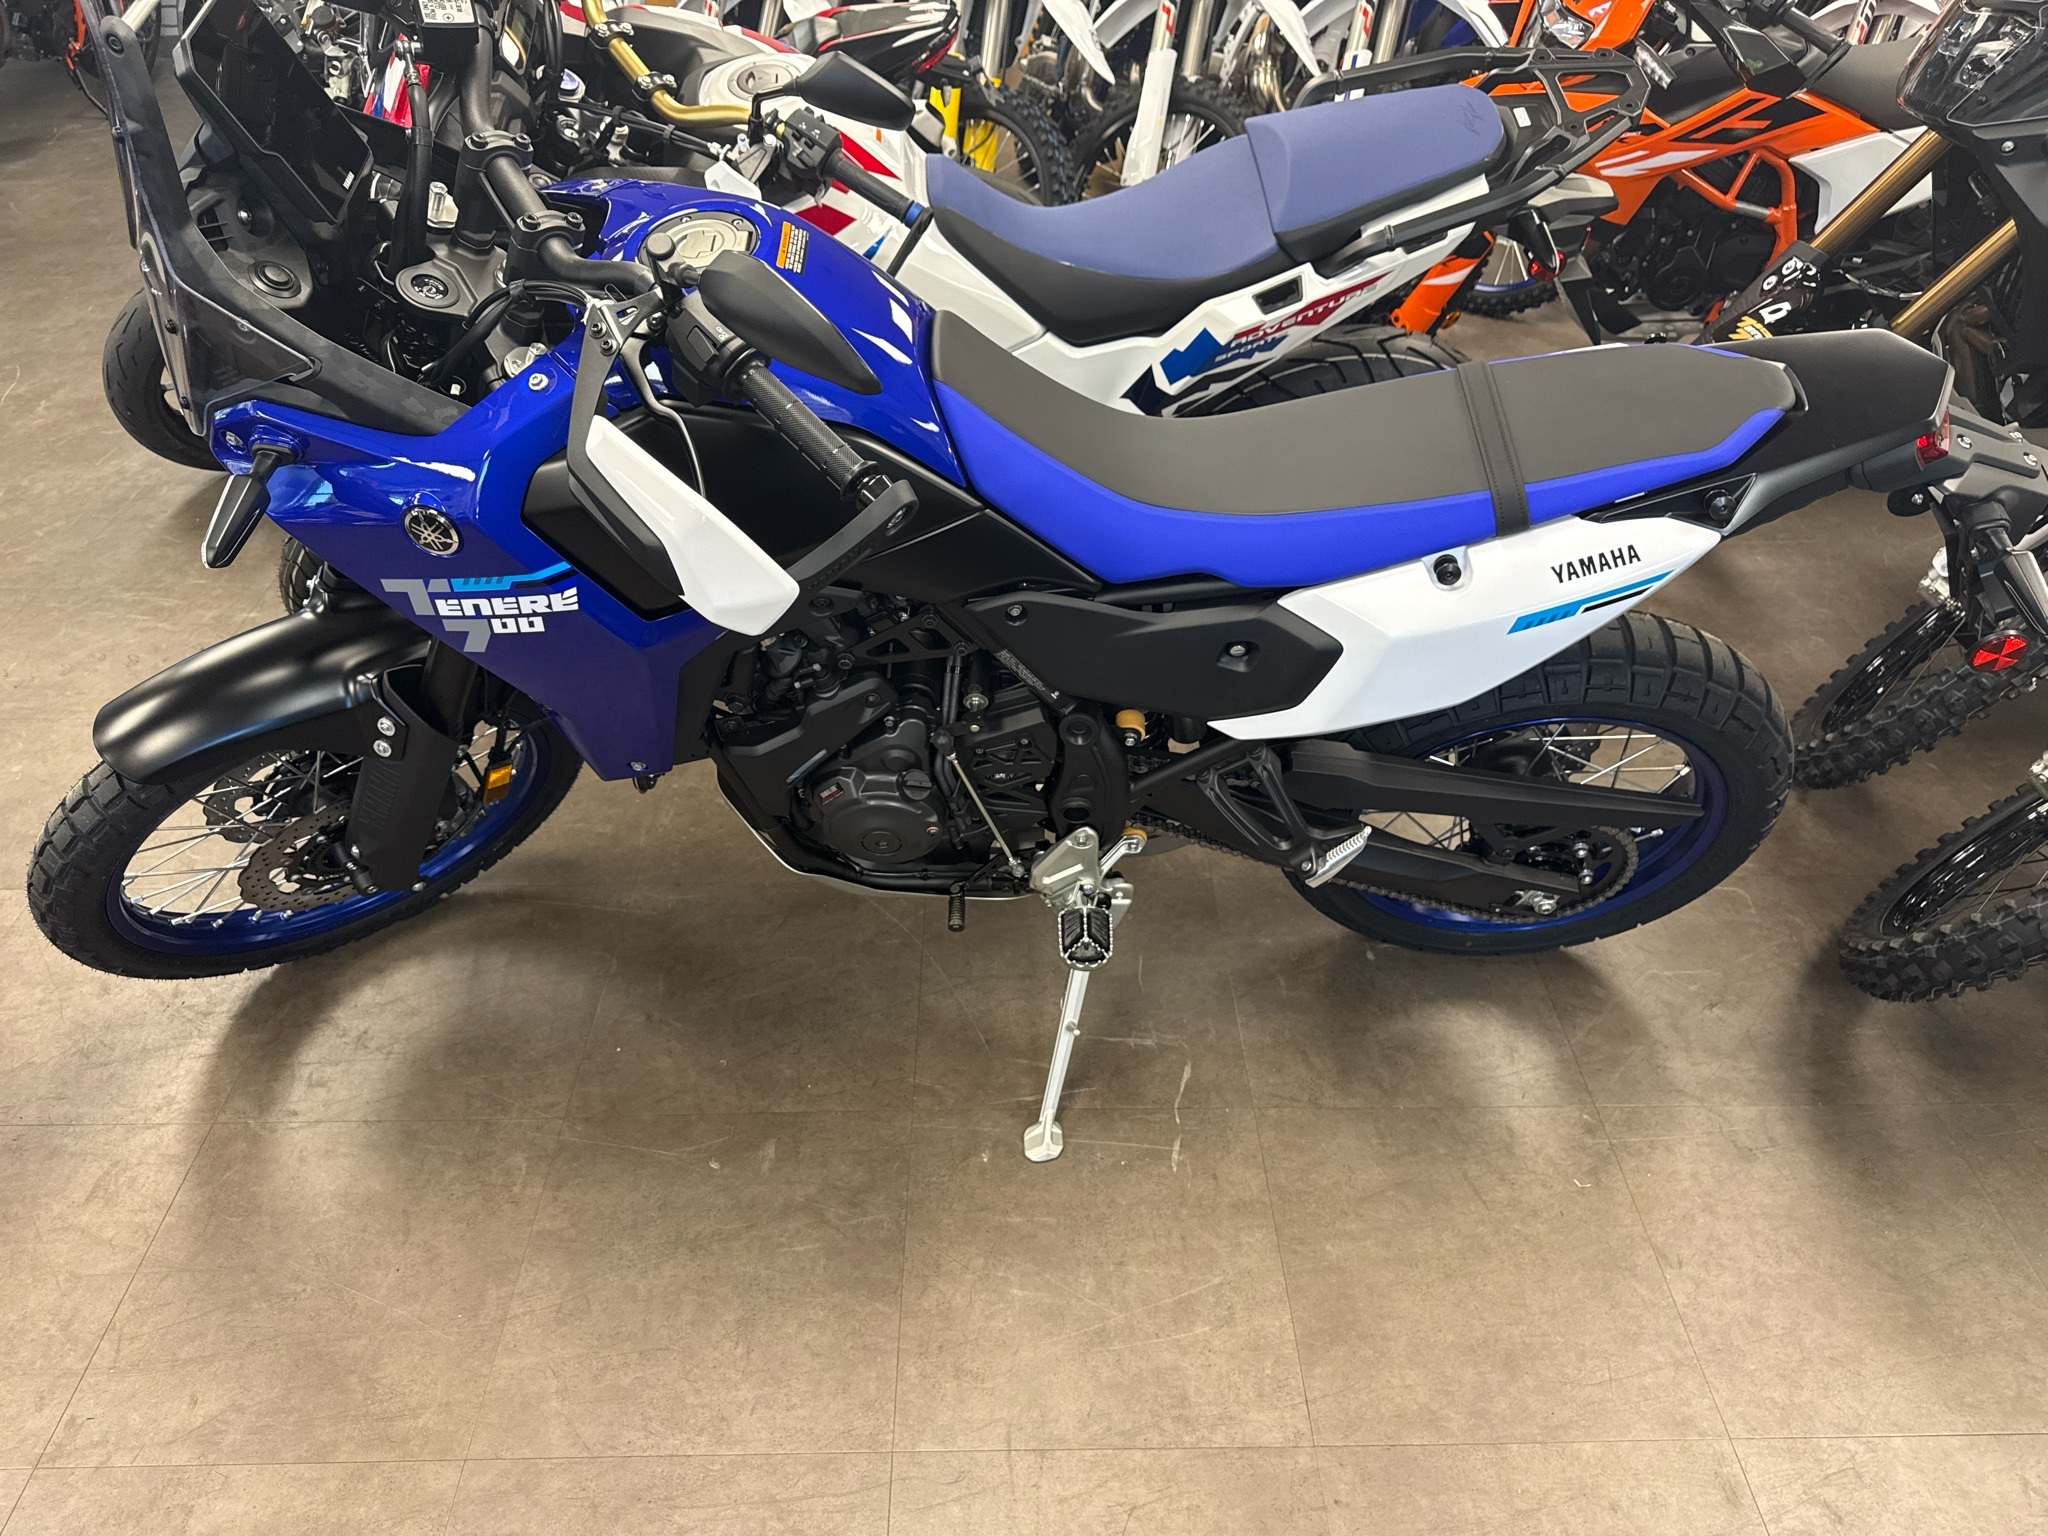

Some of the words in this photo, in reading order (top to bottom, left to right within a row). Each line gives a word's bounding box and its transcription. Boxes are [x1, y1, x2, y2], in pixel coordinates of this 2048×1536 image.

[1229, 282, 1378, 348] ADVENTURE
[1214, 331, 1289, 363] SPORTS
[1550, 544, 1641, 584] YAMAHA
[442, 616, 546, 653] 700
